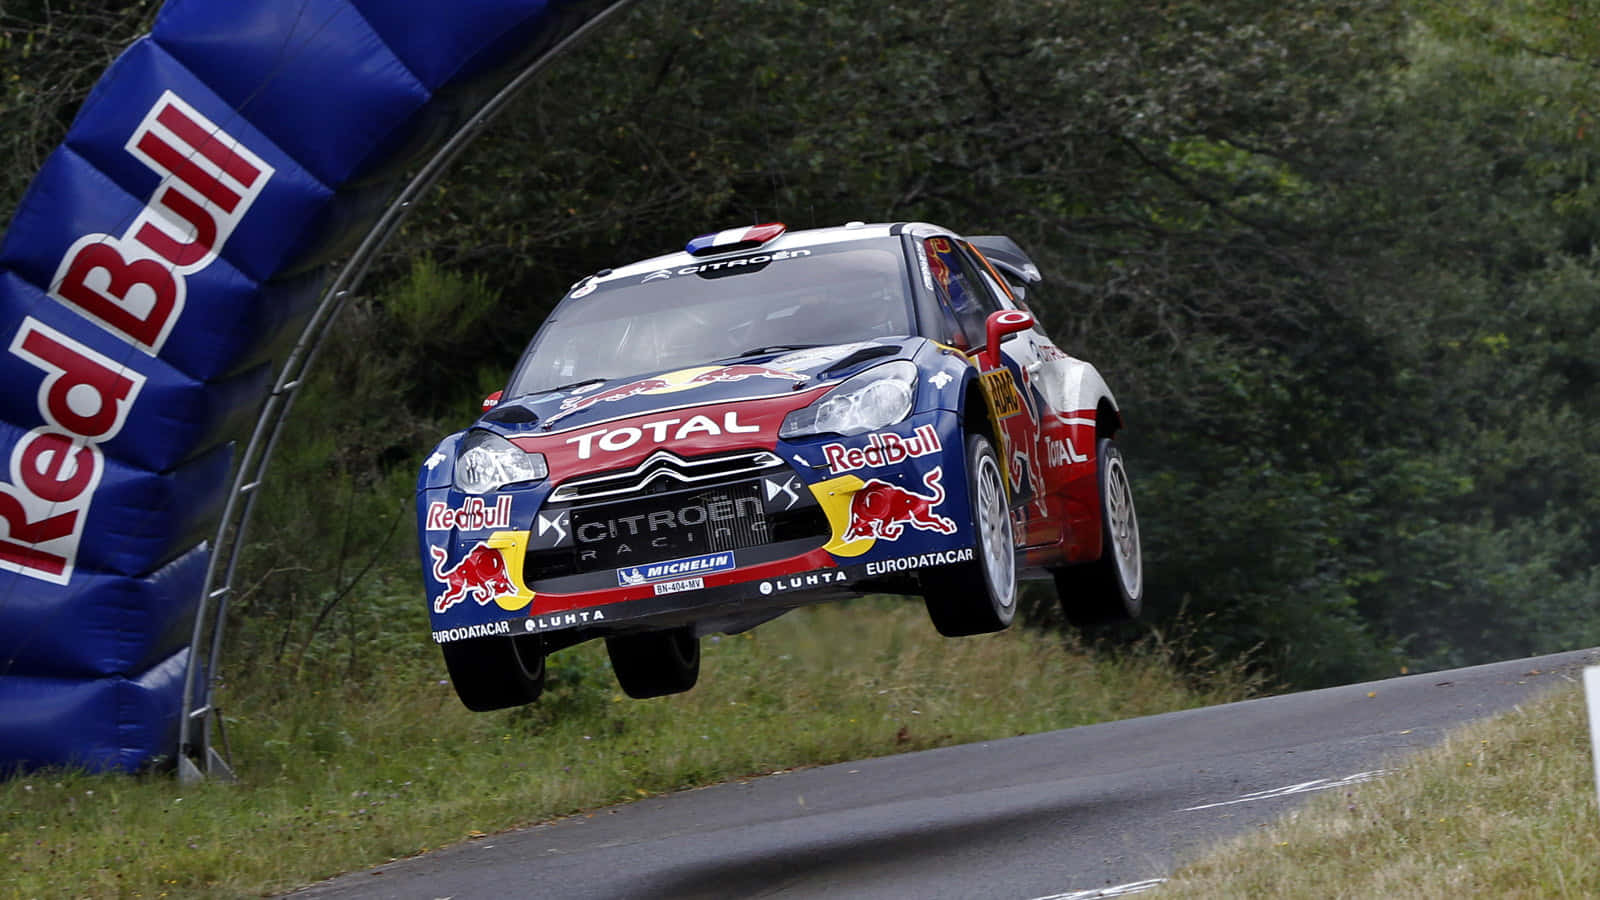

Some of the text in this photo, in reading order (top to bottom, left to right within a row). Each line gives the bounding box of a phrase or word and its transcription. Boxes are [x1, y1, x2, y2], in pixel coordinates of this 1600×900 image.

[678, 249, 812, 275] CITROËN
[0, 94, 272, 583] Red Bull
[566, 411, 760, 460] TOTAL
[1044, 438, 1088, 468] TOTAL
[576, 495, 764, 543] CITROËN
[647, 555, 729, 578] MICHELIN
[866, 548, 973, 576] EURODATACAR
[655, 578, 702, 594] BN-404-MV
[776, 571, 847, 591] LUHTA
[539, 610, 604, 628] LUHTA
